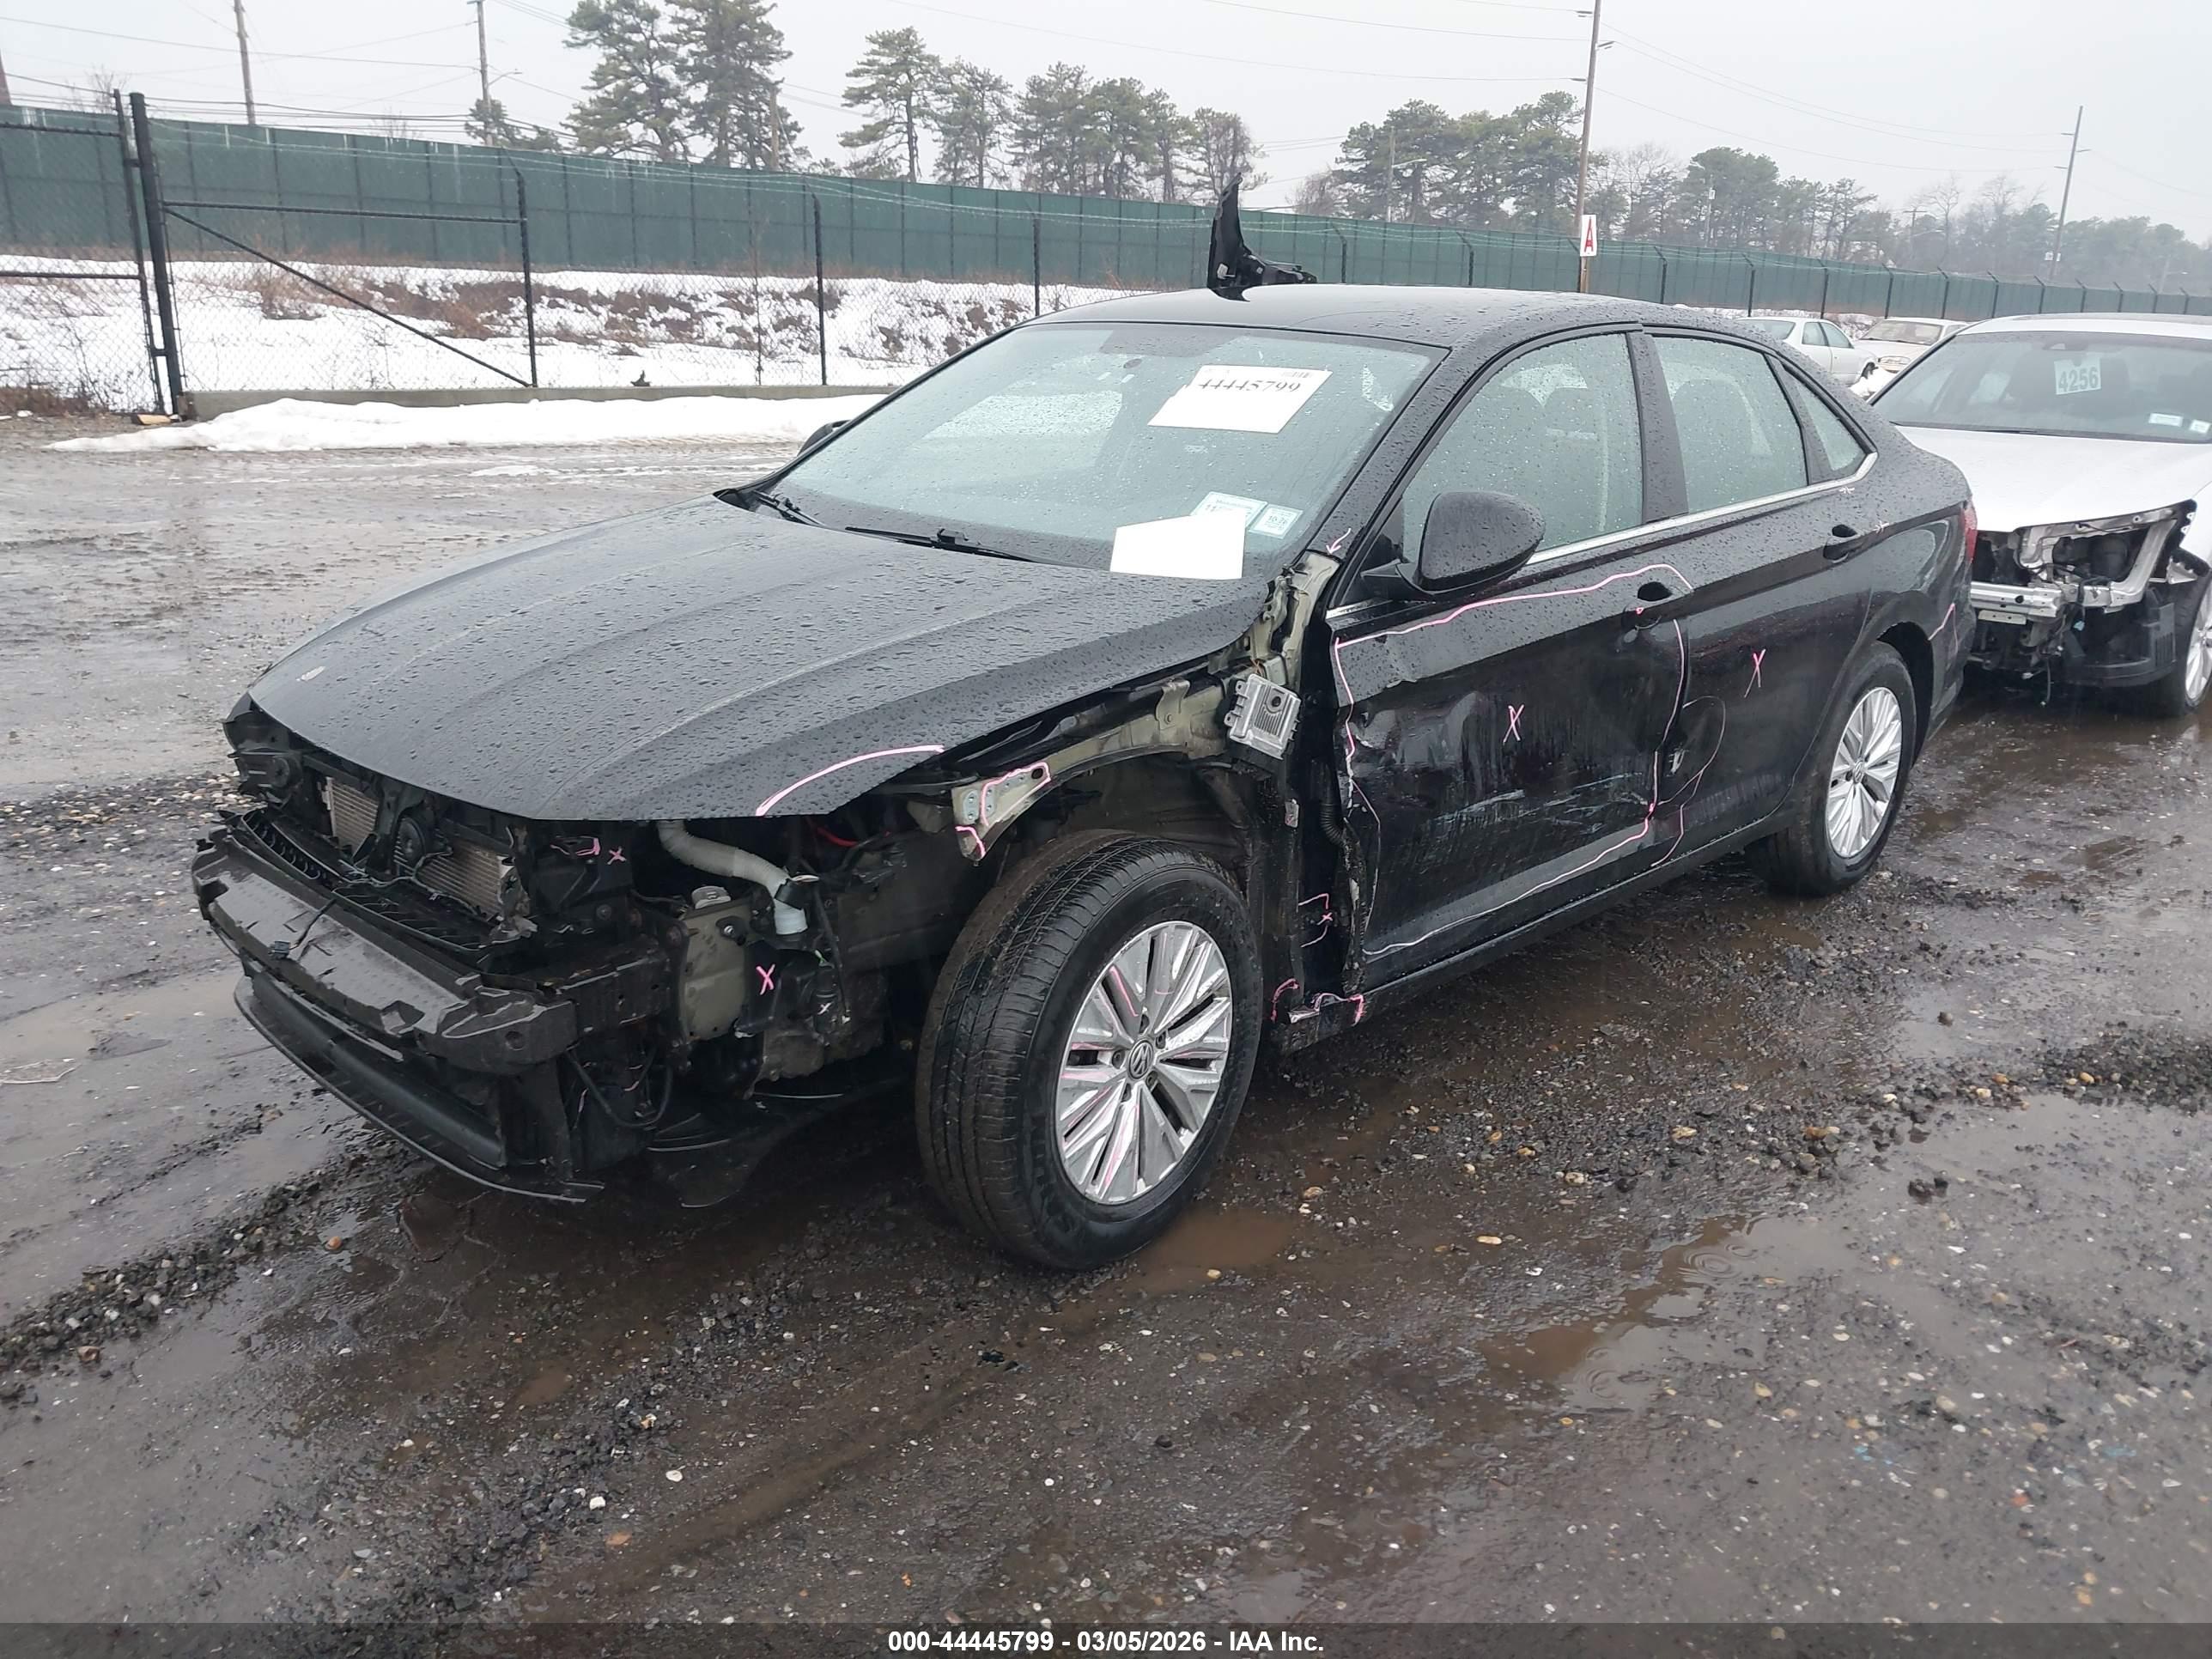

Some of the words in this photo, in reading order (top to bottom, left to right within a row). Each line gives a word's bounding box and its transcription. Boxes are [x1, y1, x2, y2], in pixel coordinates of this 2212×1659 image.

[1584, 216, 1594, 252] A
[1199, 378, 1302, 392] 44445799
[2058, 366, 2100, 392] 4256
